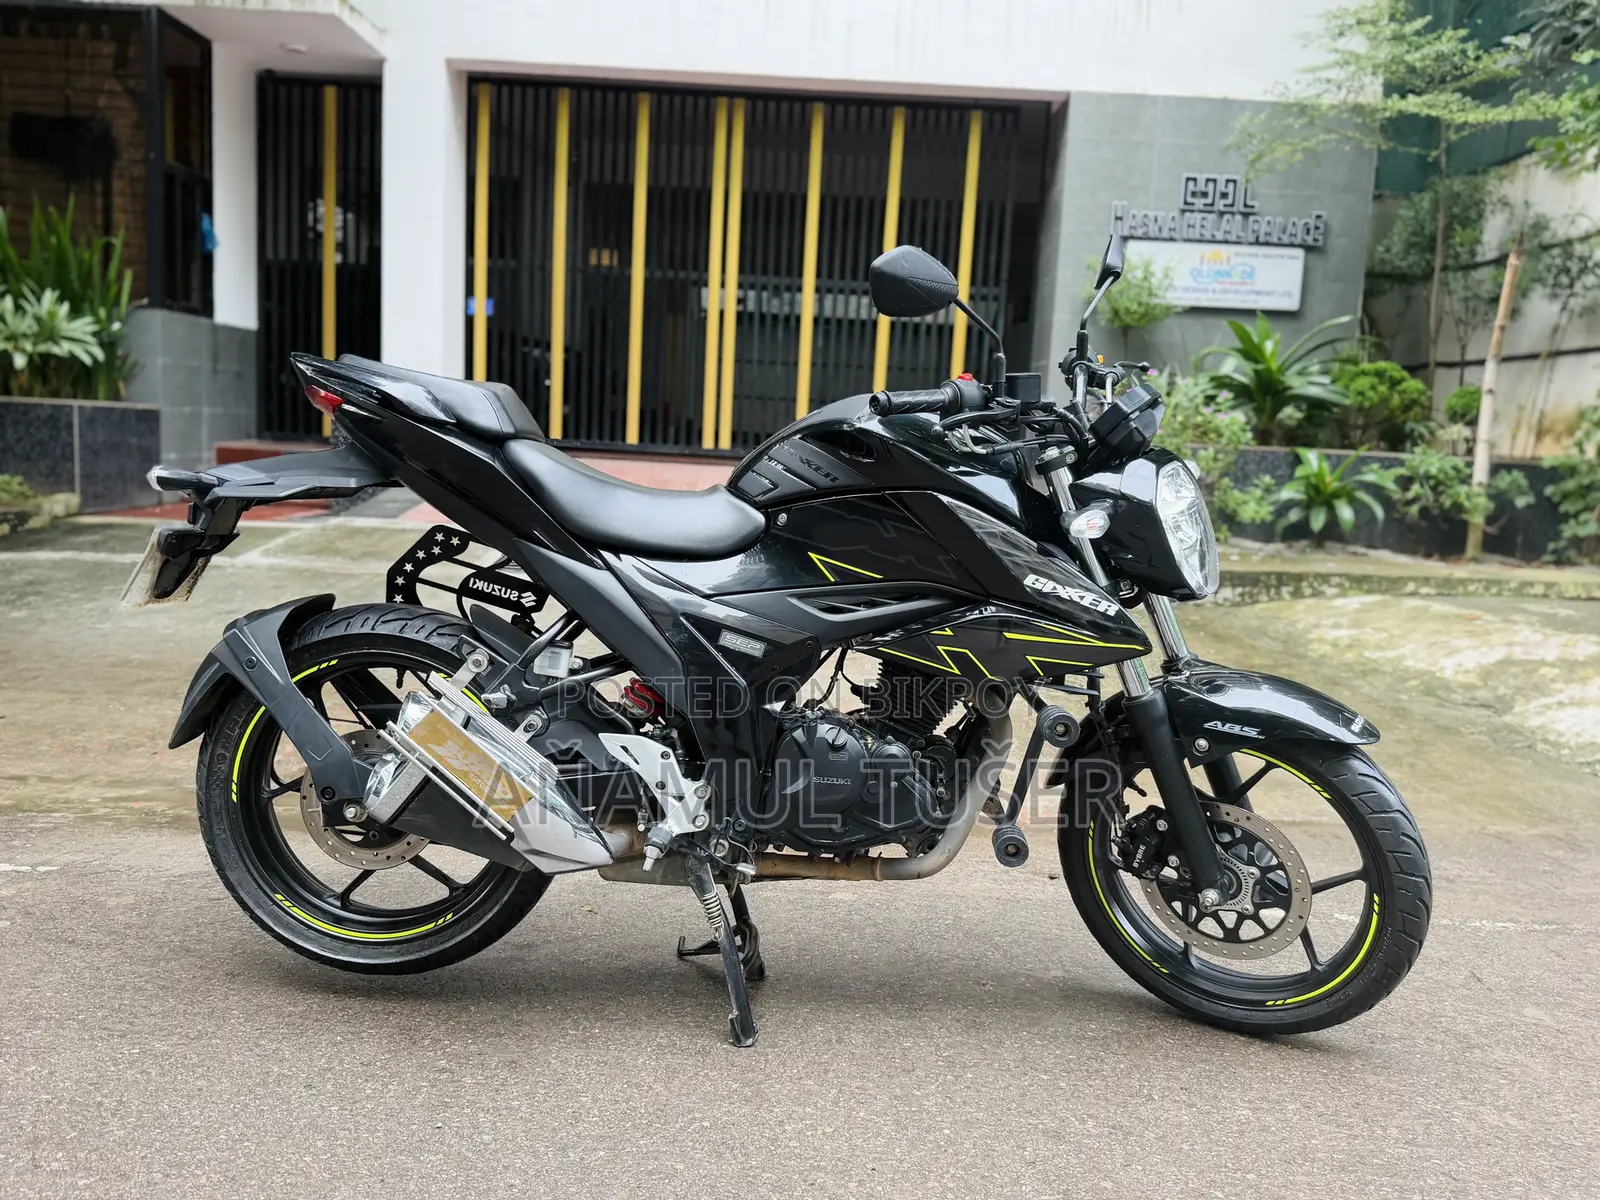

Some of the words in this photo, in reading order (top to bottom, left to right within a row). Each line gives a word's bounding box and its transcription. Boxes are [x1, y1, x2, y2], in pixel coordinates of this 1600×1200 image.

[1110, 200, 1179, 238] HASNA
[1181, 212, 1247, 243] HELAL
[1248, 211, 1327, 246] PALACE
[1023, 573, 1120, 617] GIXXER
[1203, 720, 1262, 738] ABS
[811, 776, 851, 785] SUZUKI
[1132, 844, 1147, 869] BYBRE
